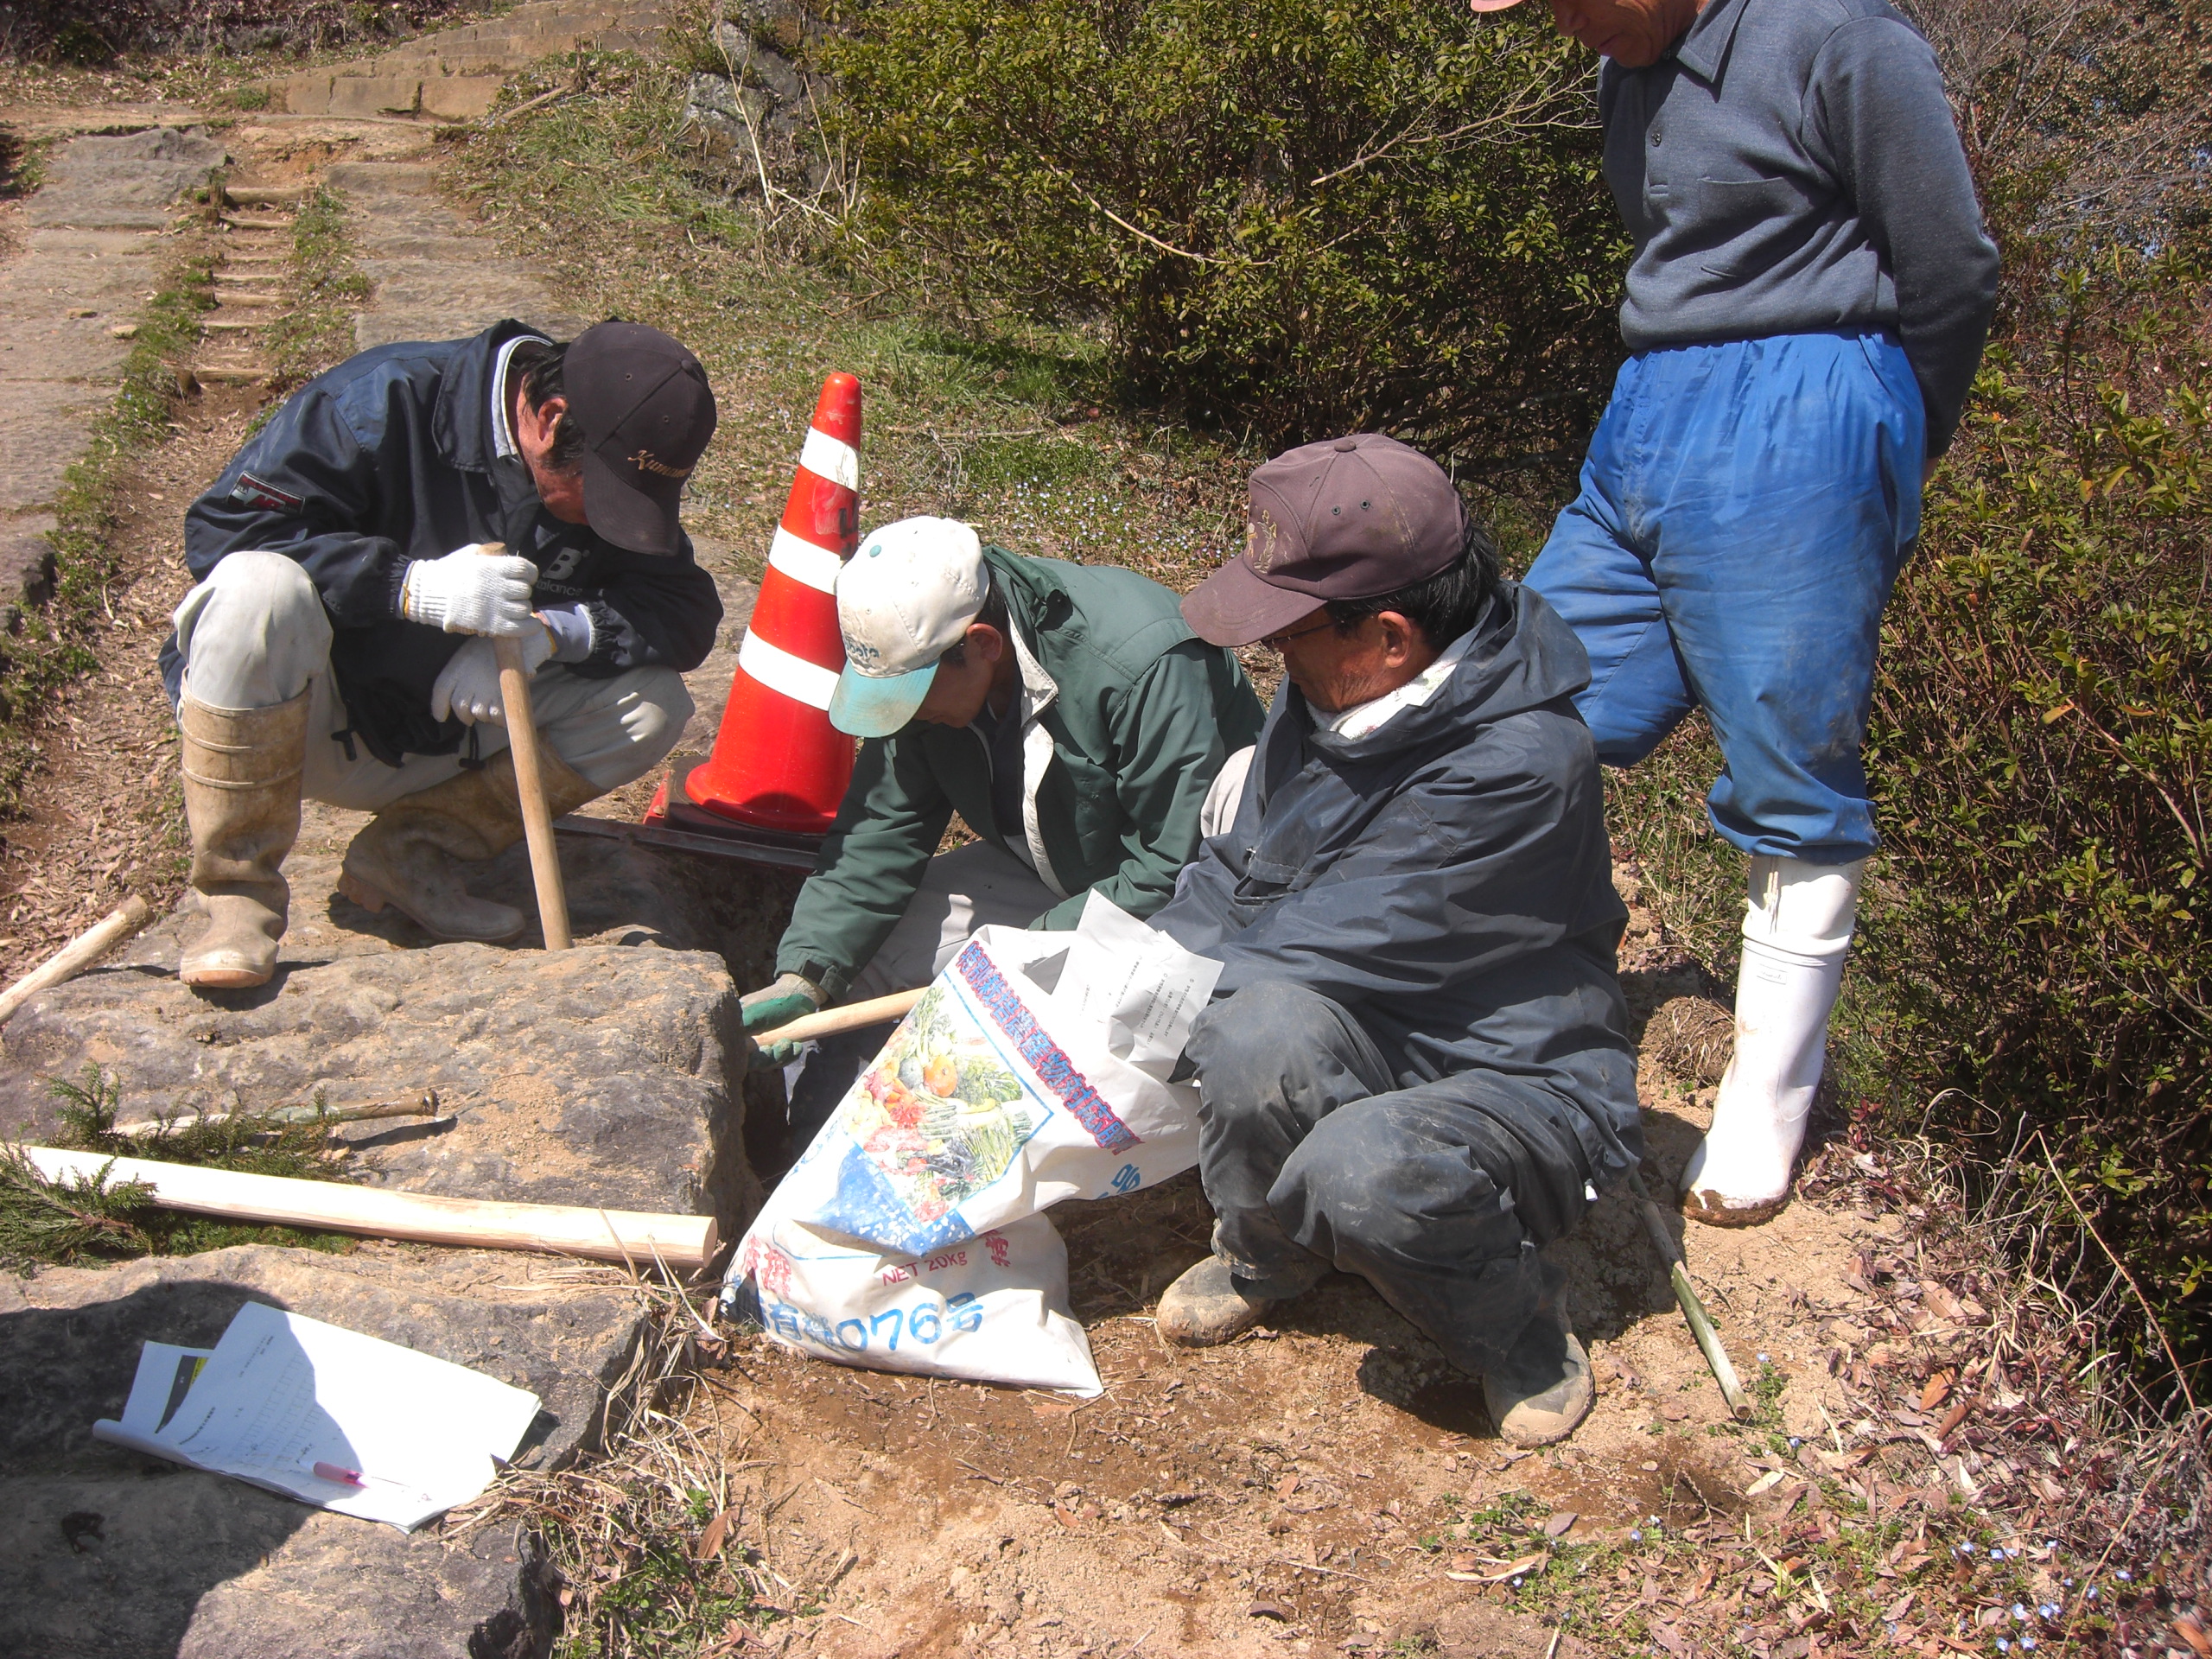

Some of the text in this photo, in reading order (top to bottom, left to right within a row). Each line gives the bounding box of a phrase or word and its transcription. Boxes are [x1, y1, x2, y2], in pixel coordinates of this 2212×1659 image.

[882, 1250, 968, 1286] NET 20kg
[762, 1291, 984, 1353] 有機076号
